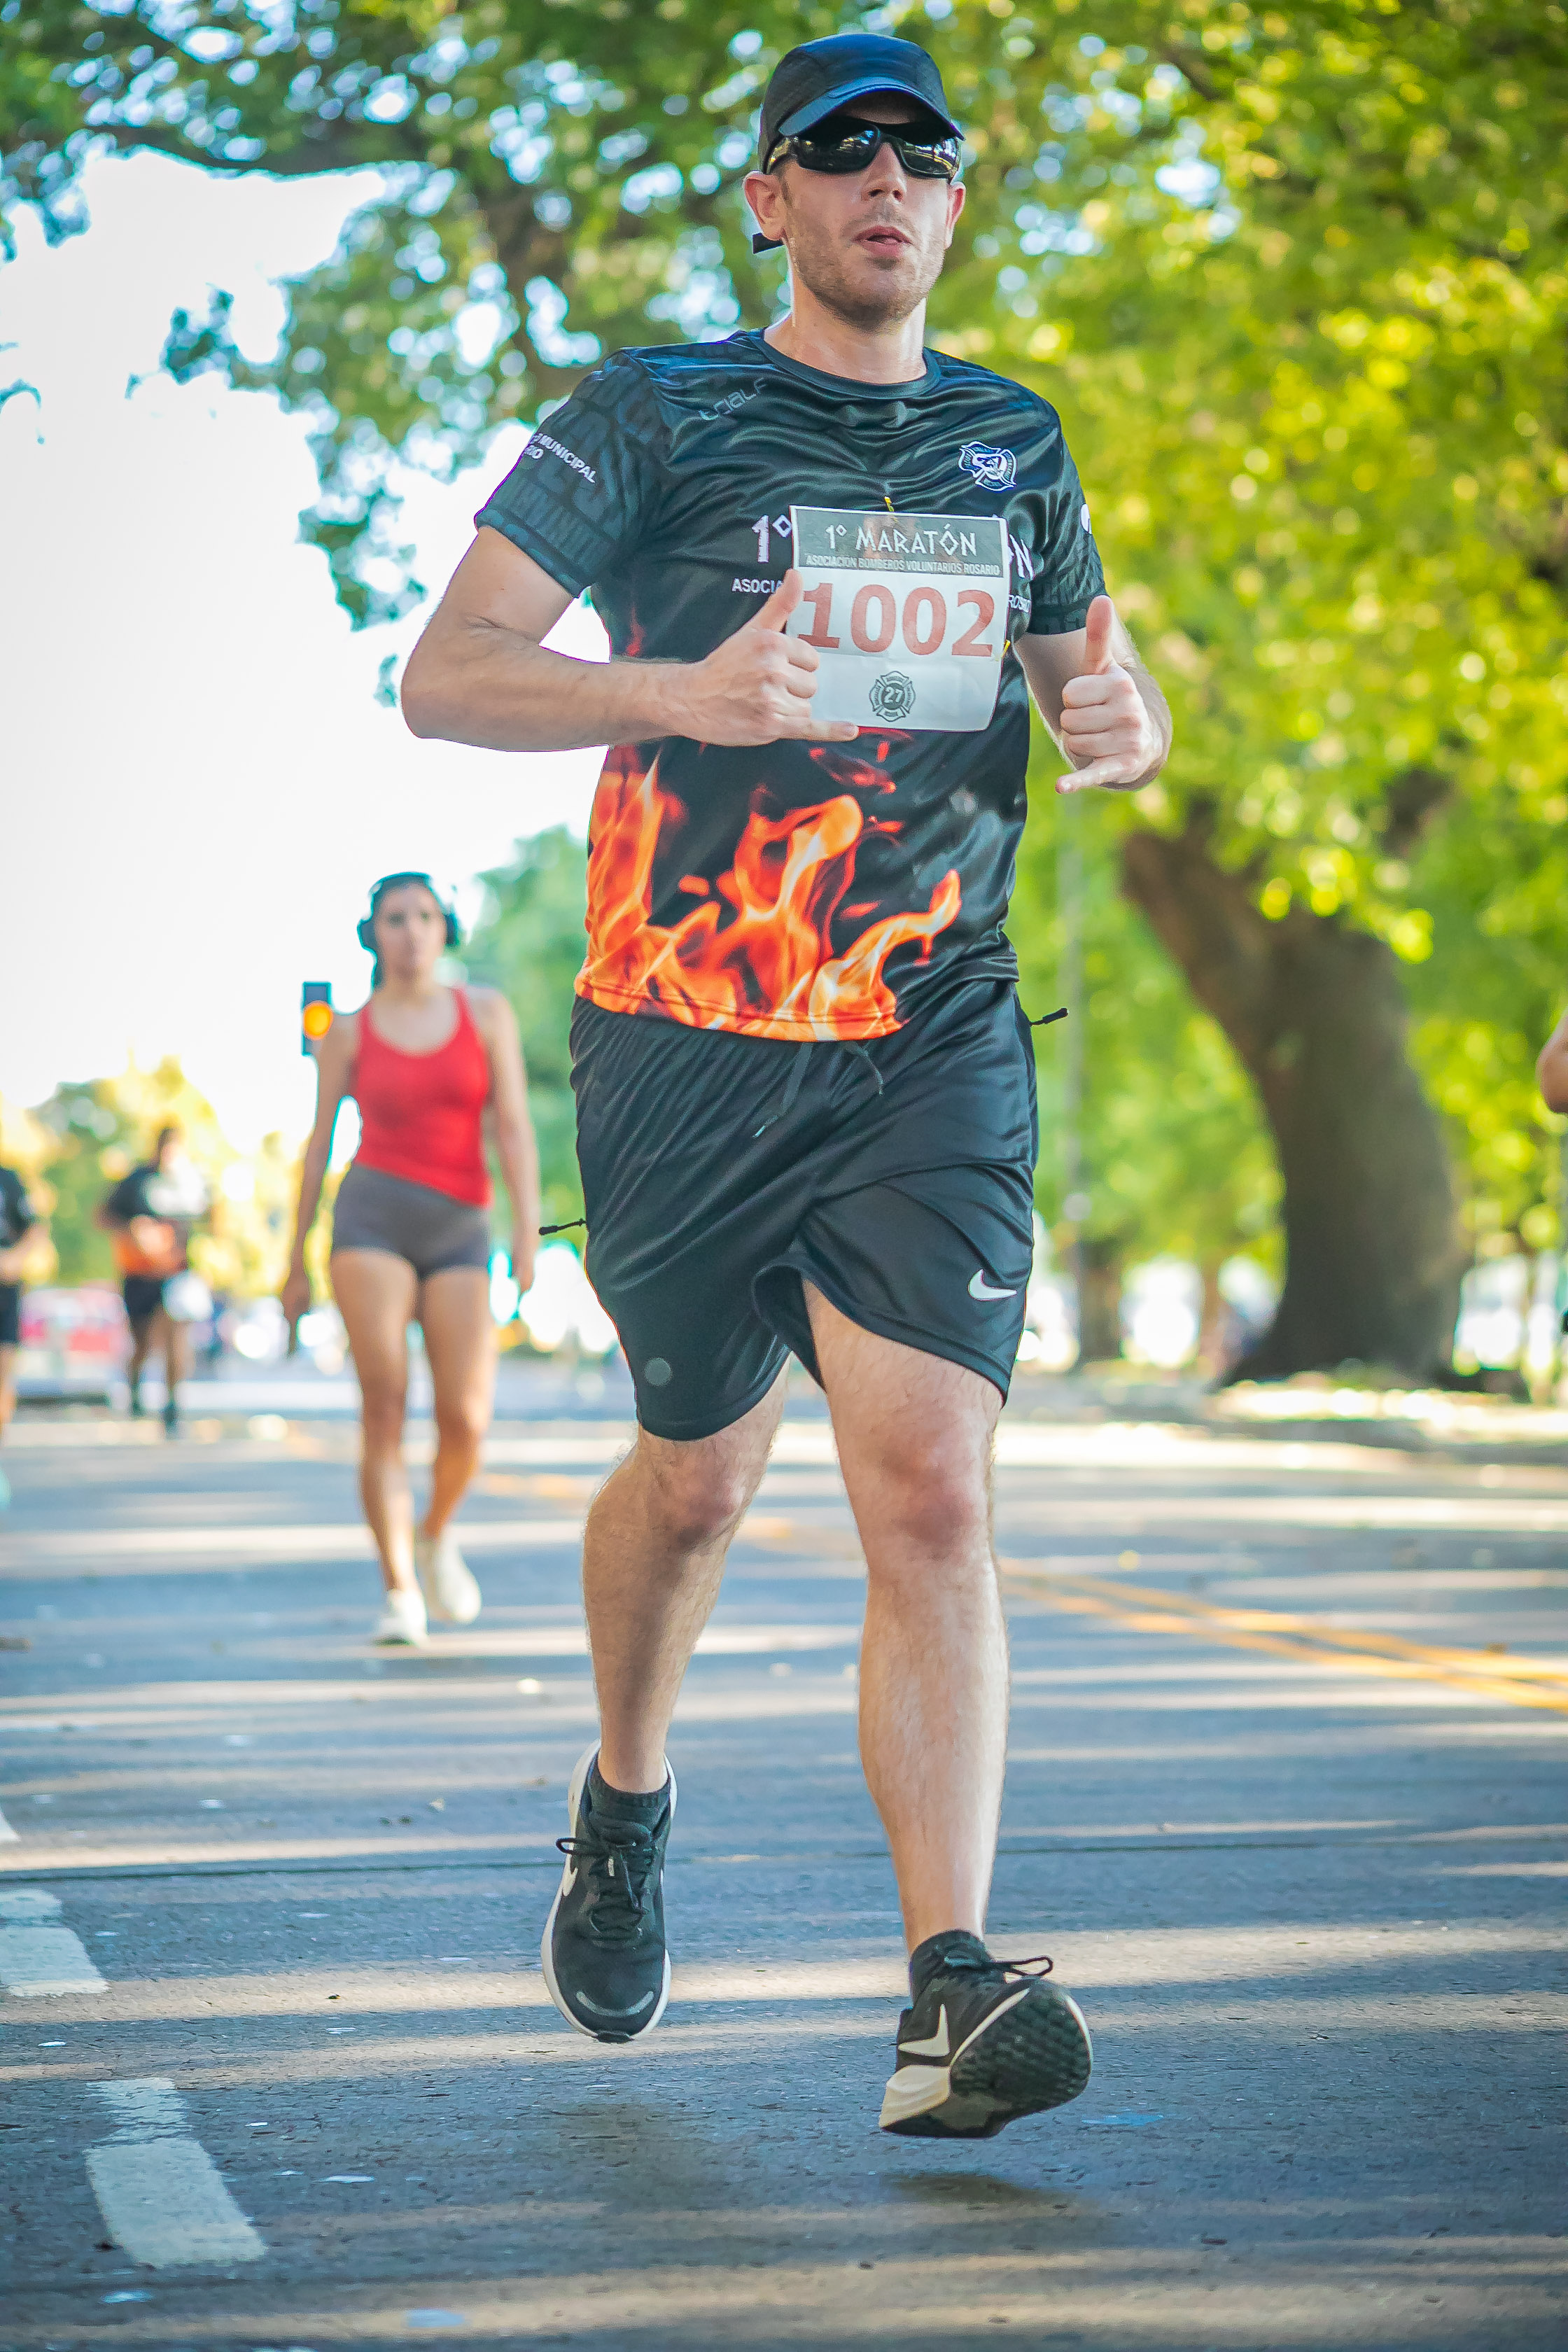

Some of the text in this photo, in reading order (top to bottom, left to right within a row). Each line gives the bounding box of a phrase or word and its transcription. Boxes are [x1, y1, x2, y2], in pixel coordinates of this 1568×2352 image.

[538, 434, 596, 483] MUNICIPAL
[855, 523, 977, 557] MARATÓN
[858, 557, 905, 572] BOMBEROS
[906, 560, 962, 575] VOLUNTARIOS
[963, 563, 1000, 576] ROSARIO
[798, 582, 995, 657] 1002
[883, 686, 903, 704] 27
